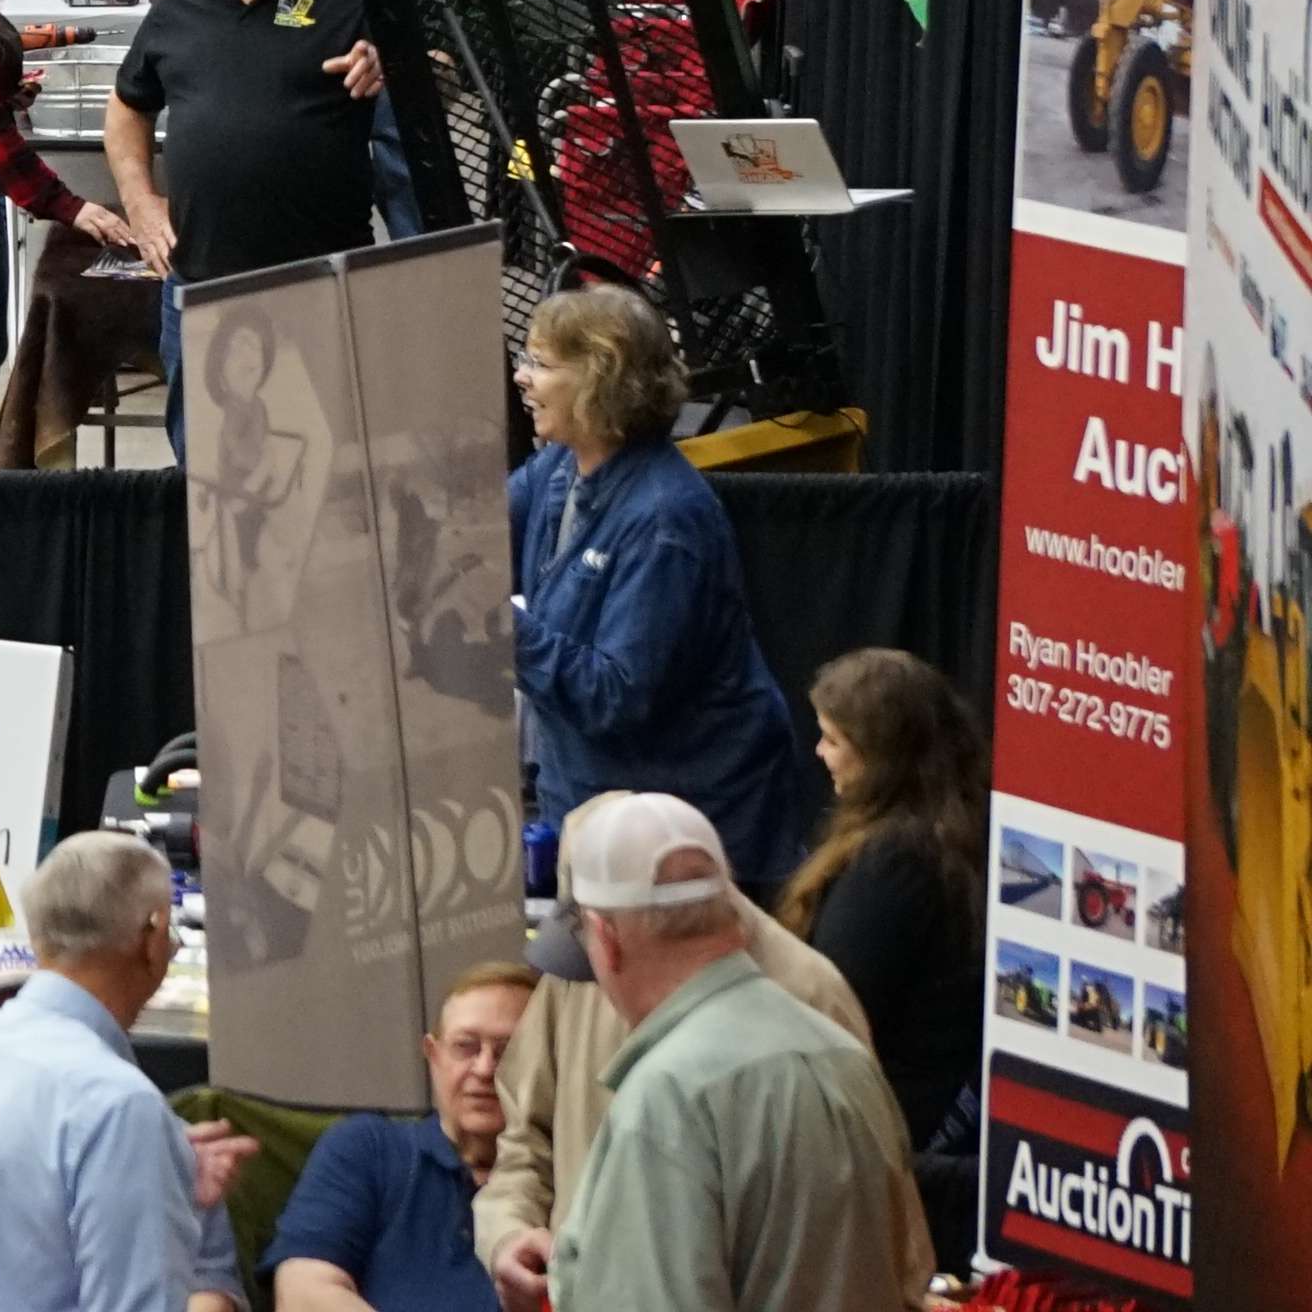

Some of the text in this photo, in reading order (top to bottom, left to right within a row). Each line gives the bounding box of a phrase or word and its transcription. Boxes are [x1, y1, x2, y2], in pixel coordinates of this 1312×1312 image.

[1036, 299, 1131, 385] Jim
[1009, 621, 1174, 697] Ryan Hoobler
[1007, 673, 1172, 751] 307-272-9775
